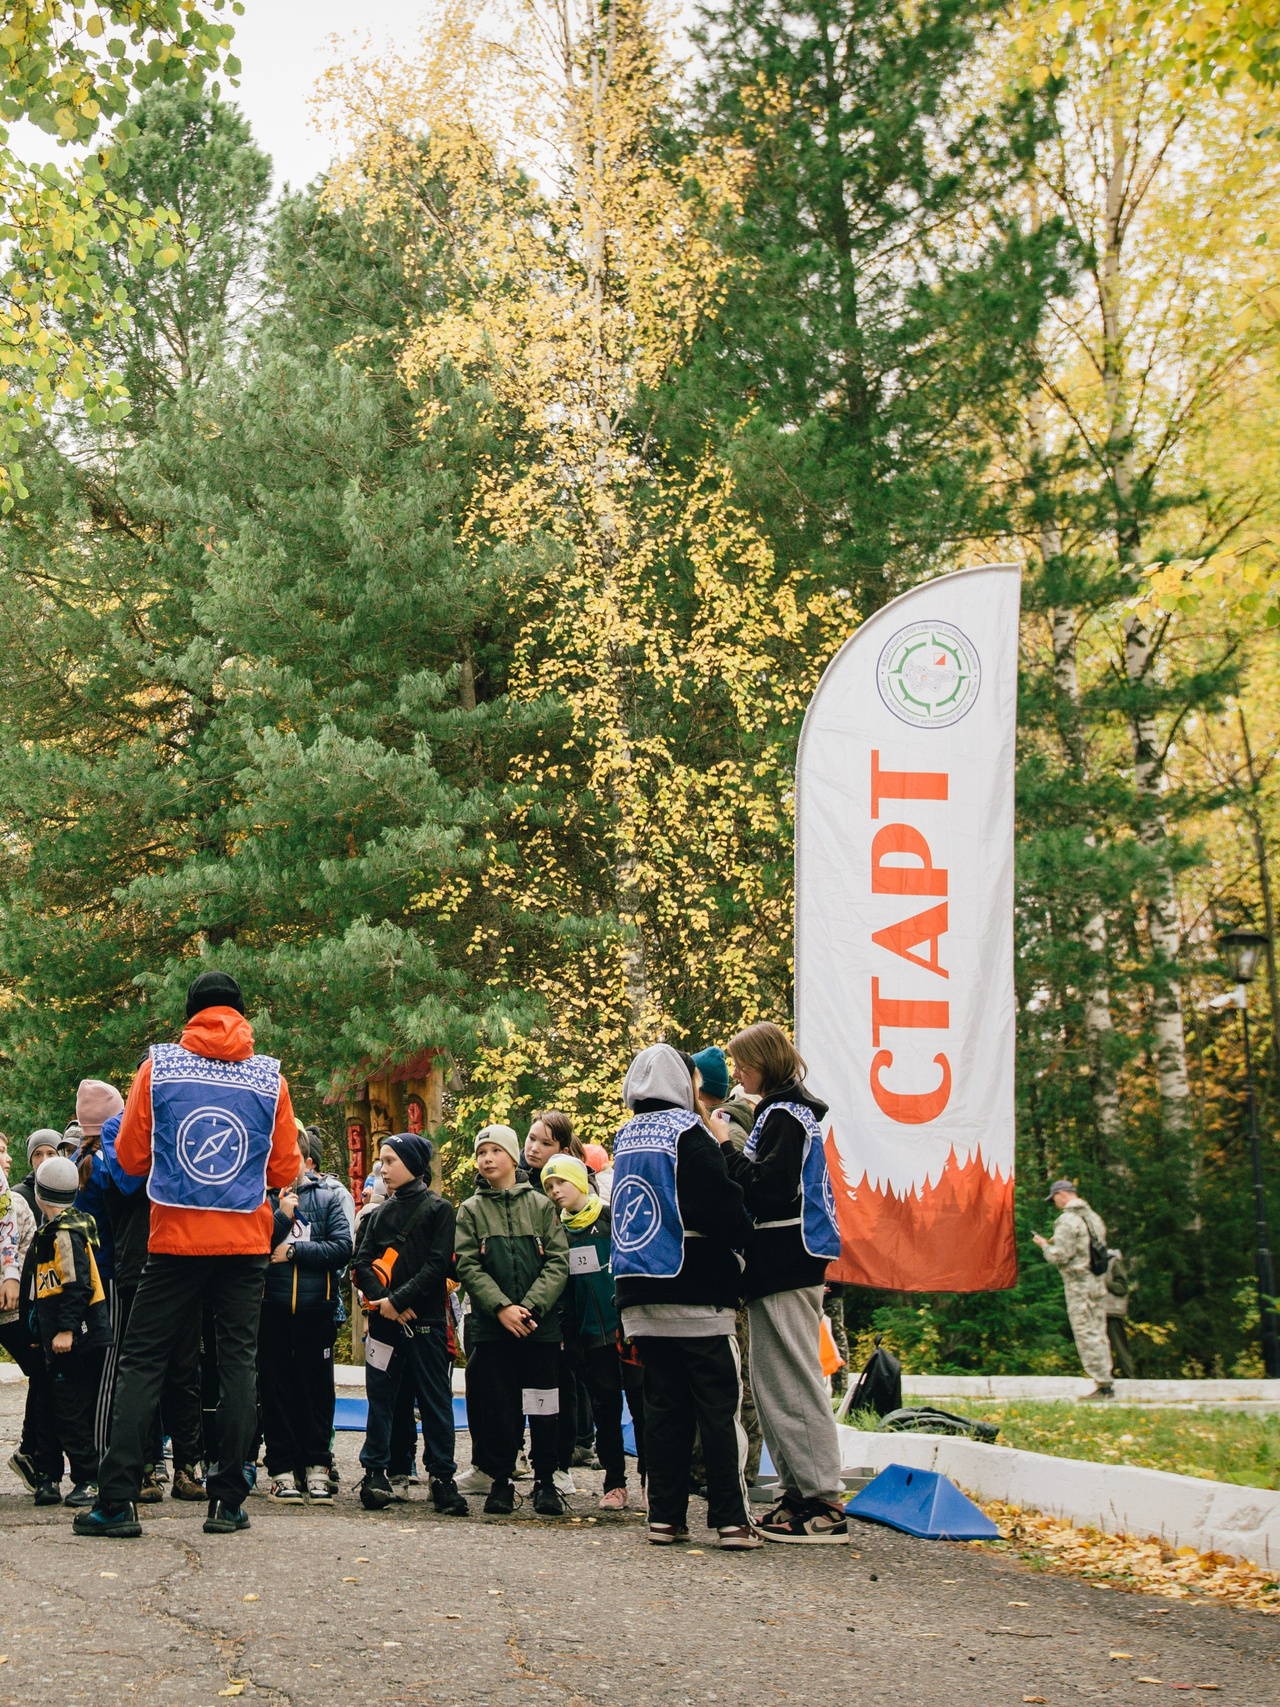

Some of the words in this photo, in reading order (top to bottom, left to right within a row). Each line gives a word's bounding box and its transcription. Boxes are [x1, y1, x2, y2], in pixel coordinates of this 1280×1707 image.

[881, 633, 903, 667] ФЕДЕРАЦИЯ
[904, 624, 943, 636] СПОРТИВНОГО
[870, 749, 951, 1125] СТАРТ
[577, 1256, 587, 1265] 32
[538, 1398, 545, 1408] 7
